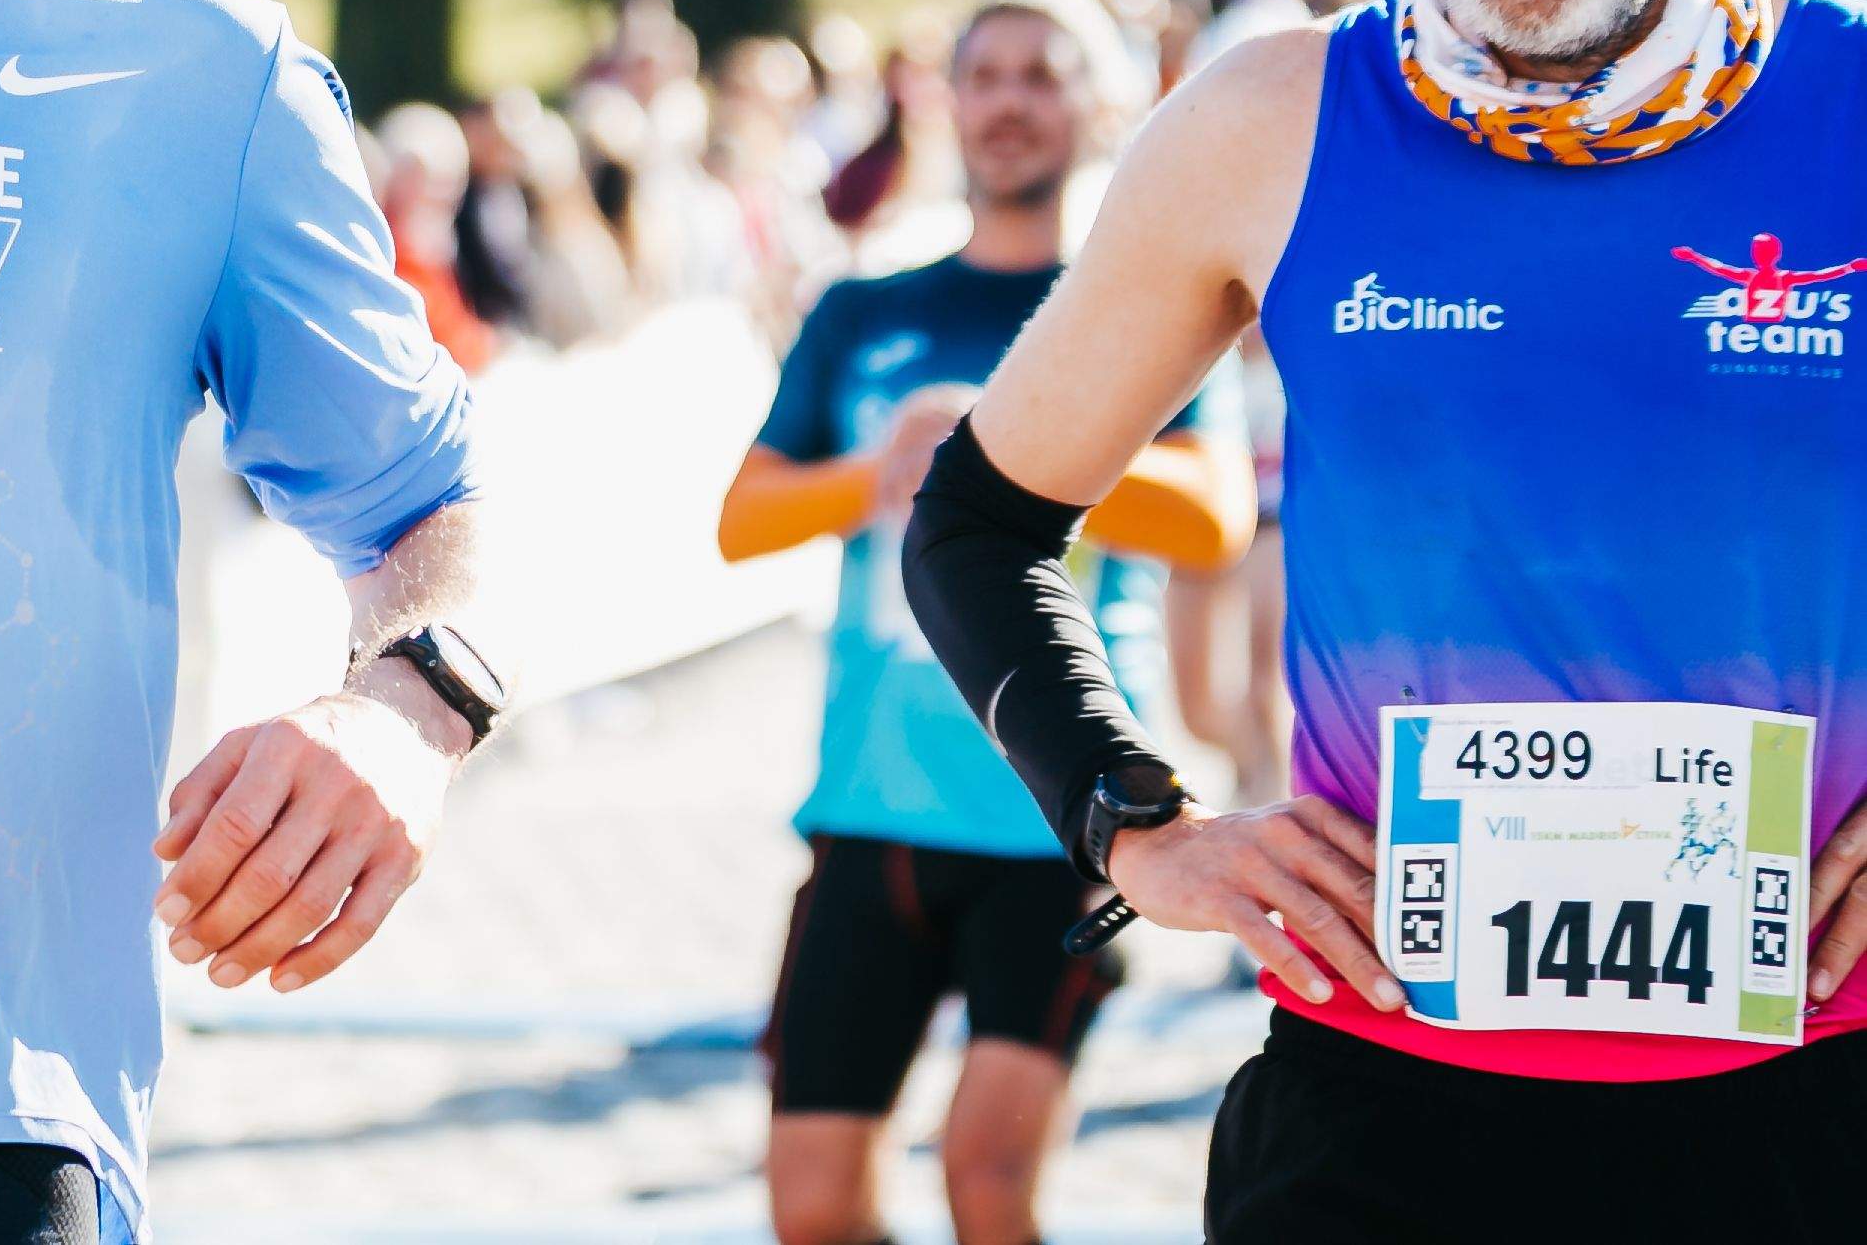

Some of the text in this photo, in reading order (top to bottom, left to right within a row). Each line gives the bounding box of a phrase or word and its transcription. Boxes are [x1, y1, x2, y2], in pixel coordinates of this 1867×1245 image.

[1707, 321, 1844, 357] team
[1455, 729, 1593, 781] 4399
[1490, 900, 1714, 1005] 1444
